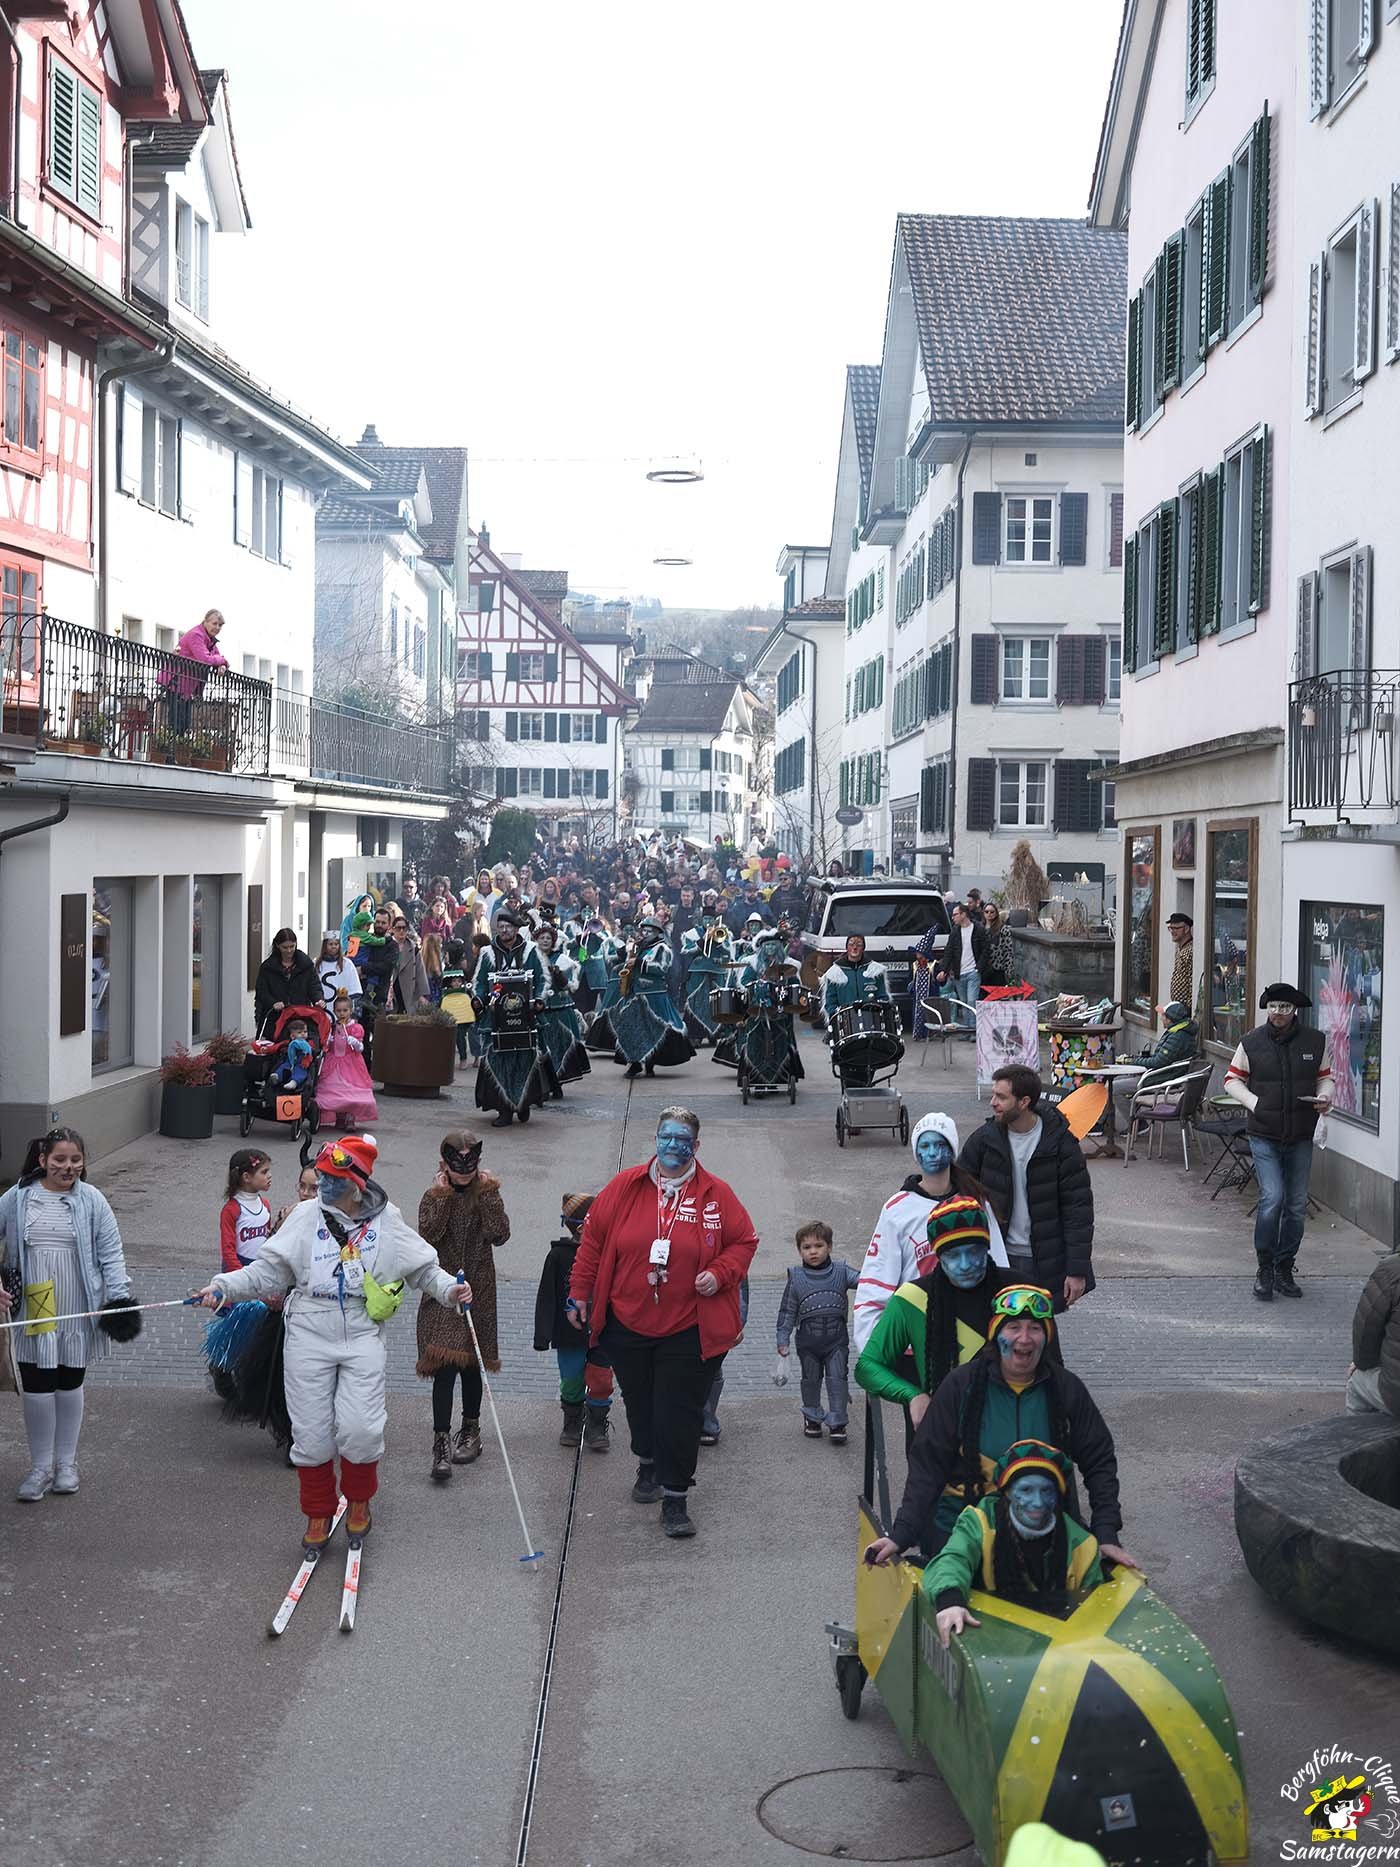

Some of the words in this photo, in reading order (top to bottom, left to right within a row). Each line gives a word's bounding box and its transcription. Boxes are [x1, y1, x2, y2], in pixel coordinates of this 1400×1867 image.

[1313, 917, 1328, 940] helga
[321, 971, 337, 1003] S
[282, 1100, 294, 1117] C
[867, 1234, 881, 1257] 5
